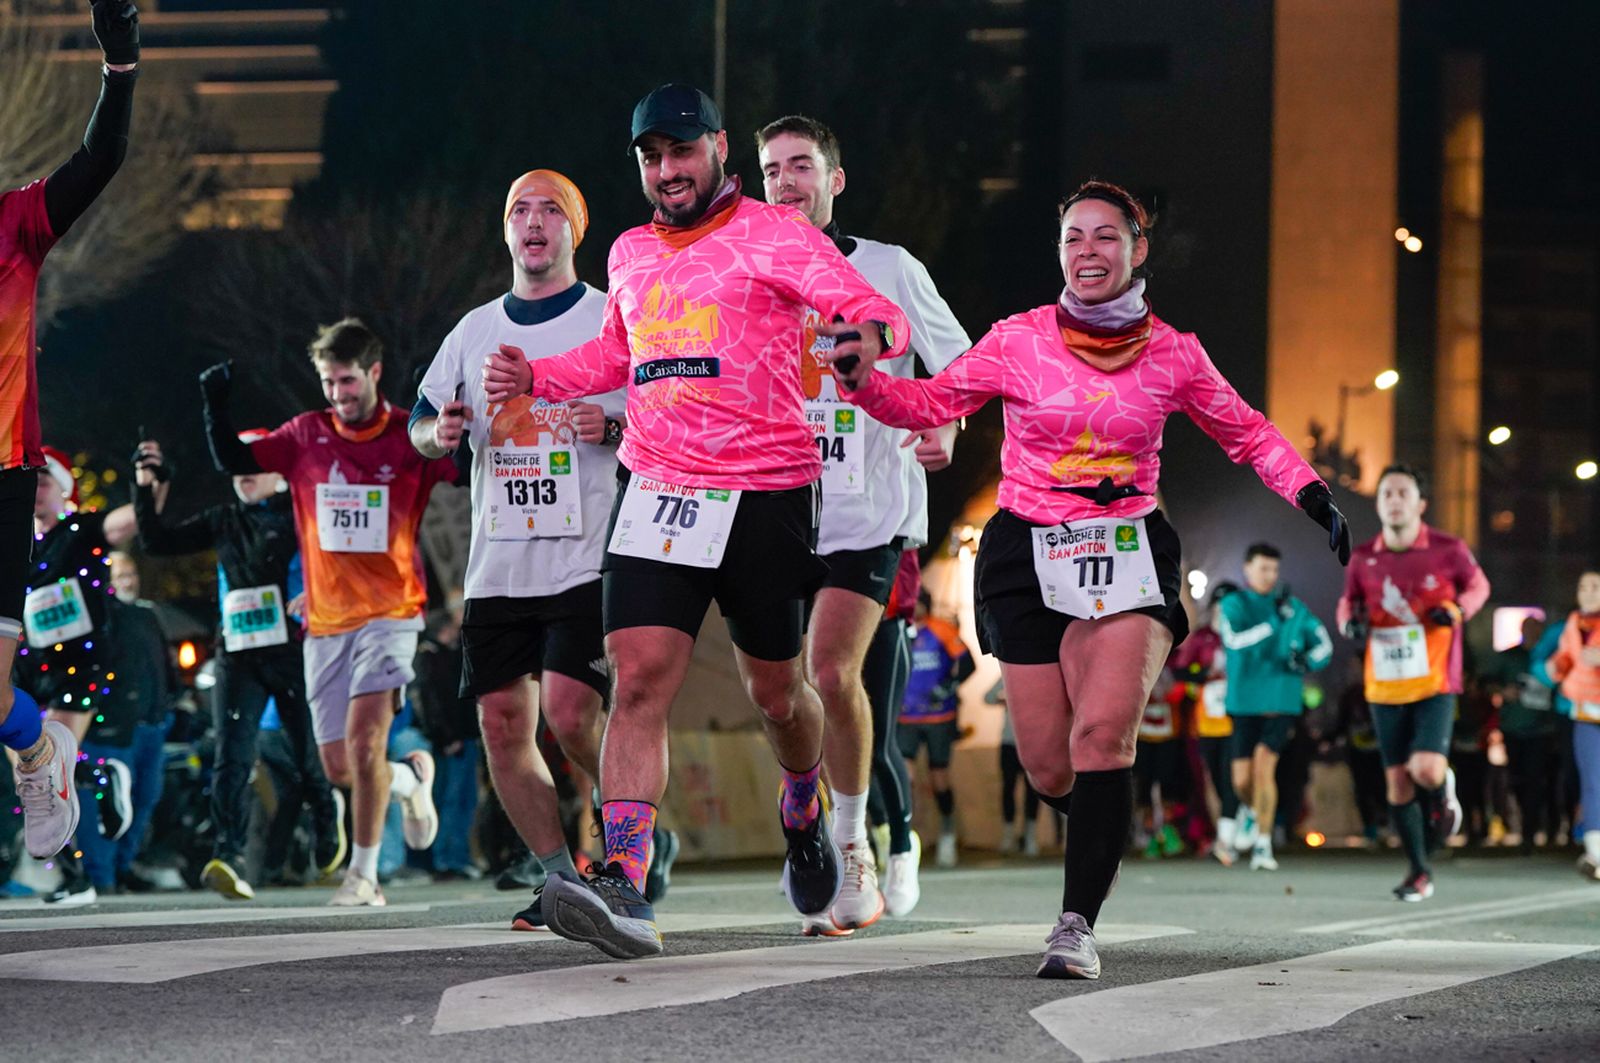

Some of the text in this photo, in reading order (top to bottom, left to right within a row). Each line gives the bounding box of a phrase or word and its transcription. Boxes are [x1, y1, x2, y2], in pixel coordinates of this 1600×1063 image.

[646, 361, 710, 379] CaixaBank
[814, 435, 846, 462] 04
[503, 456, 540, 465] NOCHE DE
[495, 467, 509, 477] SAN
[504, 479, 557, 505] 1313
[640, 480, 660, 491] SAN
[332, 509, 369, 528] 7511
[652, 495, 700, 529] 776
[1060, 530, 1093, 545] NOCHE
[1094, 529, 1106, 539] DE
[1048, 548, 1071, 560] SAN
[1073, 540, 1106, 556] ANTÓN
[1073, 556, 1114, 588] 777
